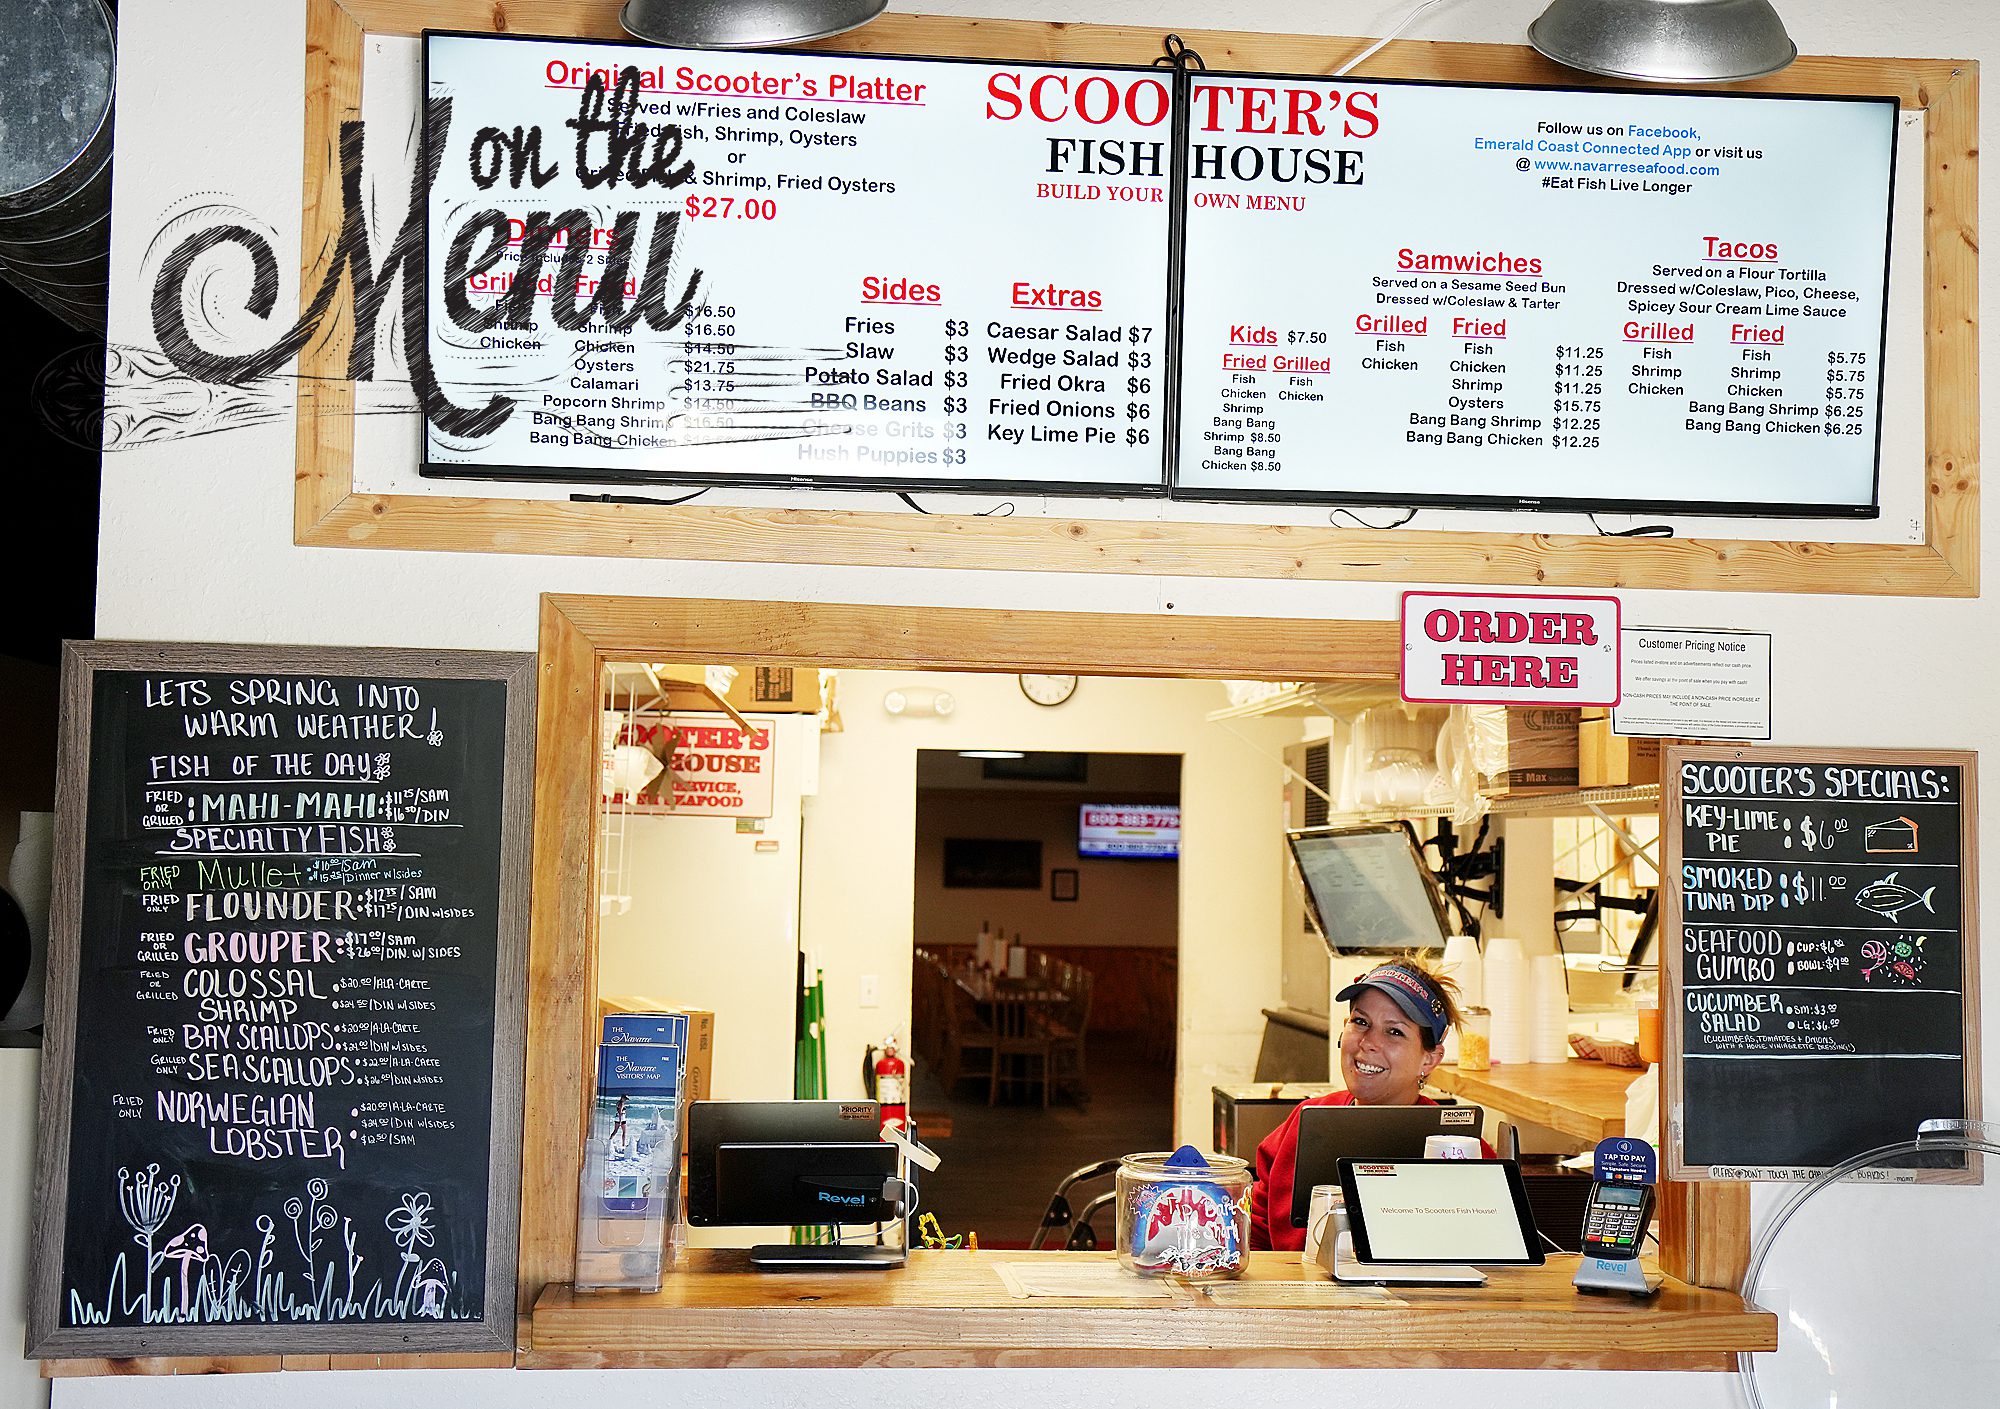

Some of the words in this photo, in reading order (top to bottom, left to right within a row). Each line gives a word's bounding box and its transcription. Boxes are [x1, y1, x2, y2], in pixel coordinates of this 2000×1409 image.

[546, 60, 664, 91] Origial
[676, 66, 817, 95] Scooter's
[828, 76, 926, 102] Platter
[608, 98, 671, 117] Seved
[676, 101, 741, 121] w/Fries
[746, 104, 780, 121] and
[785, 106, 866, 126] Coleslaw
[714, 127, 784, 147] Shrimp,
[788, 129, 857, 149] Oysters
[1537, 121, 1583, 136] Follow
[1586, 125, 1603, 137] us
[1606, 125, 1624, 137] on
[1628, 125, 1701, 142] Facebook,
[727, 150, 747, 164] or
[1474, 137, 1533, 152] Emerald
[1537, 140, 1580, 153] Coast
[1582, 141, 1659, 156] Connected
[1662, 144, 1691, 161] App
[1695, 147, 1711, 158] or
[1714, 146, 1743, 159] visit
[1746, 149, 1763, 160] us
[1046, 137, 1164, 177] FISH
[1192, 145, 1363, 186] HOUSE
[1515, 157, 1531, 173] @
[1534, 158, 1720, 177] www.navarreseafood.com
[702, 171, 771, 191] Shrimp,
[777, 175, 823, 192] Fried
[828, 176, 896, 195] Oysters
[1541, 176, 1574, 190] #Eat
[1577, 178, 1606, 191] Fish
[1610, 179, 1639, 192] Live
[1642, 180, 1692, 195] Longer
[685, 195, 777, 222] $27.00
[1036, 183, 1101, 201] BUILD
[1107, 185, 1164, 204] YOUR
[1193, 192, 1241, 210] OWN
[1246, 195, 1306, 213] MENU
[1703, 236, 1778, 259] Tacos
[1397, 248, 1542, 274] Samwiches
[1652, 264, 1702, 278] Served
[1705, 268, 1721, 278] on
[1727, 269, 1735, 279] a
[1739, 267, 1775, 280] Flour
[1778, 268, 1827, 282] Tortilla
[862, 276, 941, 301] Sides
[1011, 282, 1102, 308] Extras
[1617, 282, 1676, 295] Dressed
[1679, 284, 1762, 299] w/Coleslaw,
[1765, 286, 1799, 300] Pico,
[1803, 287, 1859, 302] Cheese,
[1628, 300, 1675, 314] Spicey
[1679, 302, 1712, 315] Sour
[1715, 302, 1762, 315] Cream
[1766, 303, 1800, 316] Lime
[1803, 305, 1847, 318] Sauce
[845, 317, 895, 335] Fries
[945, 318, 969, 338] $3
[987, 321, 1058, 341] Caesar
[1065, 324, 1121, 343] Salad
[1128, 326, 1152, 345] $7
[1230, 325, 1278, 345] Kids
[1287, 330, 1327, 346] $7.50
[1355, 314, 1427, 334] Grilled
[1452, 317, 1506, 337] Fried
[846, 342, 894, 360] Slaw
[945, 344, 969, 363] $3
[574, 358, 634, 374] Oysters
[570, 377, 639, 391] Calamari
[543, 394, 607, 410] Popcorn
[611, 396, 665, 411] Shrimp
[988, 424, 1024, 445] Key
[1031, 426, 1078, 443] Lime
[1085, 427, 1116, 444] Pie
[1126, 427, 1150, 446] $6
[1424, 609, 1598, 645] ORDER
[1638, 638, 1683, 650] Customer
[1685, 640, 1715, 653] Pricing
[1717, 642, 1746, 653] Notice
[1441, 653, 1578, 688] HERE
[145, 680, 212, 708] LETS
[229, 680, 340, 708] SPRING
[358, 684, 420, 711] INTO
[184, 709, 279, 739] WARM
[150, 755, 210, 779] FISH
[233, 755, 259, 776] OF
[271, 754, 313, 777] THE
[325, 752, 373, 782] DAY
[1526, 773, 1548, 782] Max
[1682, 764, 1815, 797] SCOOTER'S
[1825, 767, 1950, 799] SPECIALS:
[145, 791, 183, 803] FRIED
[155, 804, 169, 813] OR
[202, 791, 375, 822] MAHI-MAHI
[142, 815, 184, 828] GRILLED
[1686, 804, 1779, 830] KEY-LIME
[320, 825, 381, 855] FISH
[1706, 832, 1741, 853] PIE
[140, 865, 180, 882] FRIED
[198, 859, 302, 891] Mullet
[1682, 865, 1773, 890] SMOKED
[142, 894, 180, 906] FRIED
[186, 890, 357, 921] FLOUNDER
[1682, 891, 1736, 912] TUNA
[1741, 893, 1775, 911] DIP
[184, 930, 335, 964] GROUPER
[1685, 929, 1782, 955] SEAFOOD
[1697, 954, 1776, 982] GUMBO
[183, 967, 328, 999] COLOSSAL
[198, 998, 299, 1024] SHRIMP
[1686, 992, 1784, 1013] CUCUMBER
[1701, 1012, 1761, 1033] SALAD
[183, 1023, 233, 1050] BAY
[239, 1022, 335, 1053] SCALLOPS
[150, 1055, 187, 1065] GRILLED
[187, 1053, 239, 1081] SEA
[243, 1056, 355, 1088] SCALLOPS
[158, 1090, 314, 1128] NORWEGIAN
[211, 1126, 345, 1170] LOBSTER
[1767, 1169, 1789, 1180] TOUCH
[1792, 1169, 1806, 1180] THE
[818, 1191, 865, 1205] Revel
[1596, 1260, 1628, 1273] Revel
